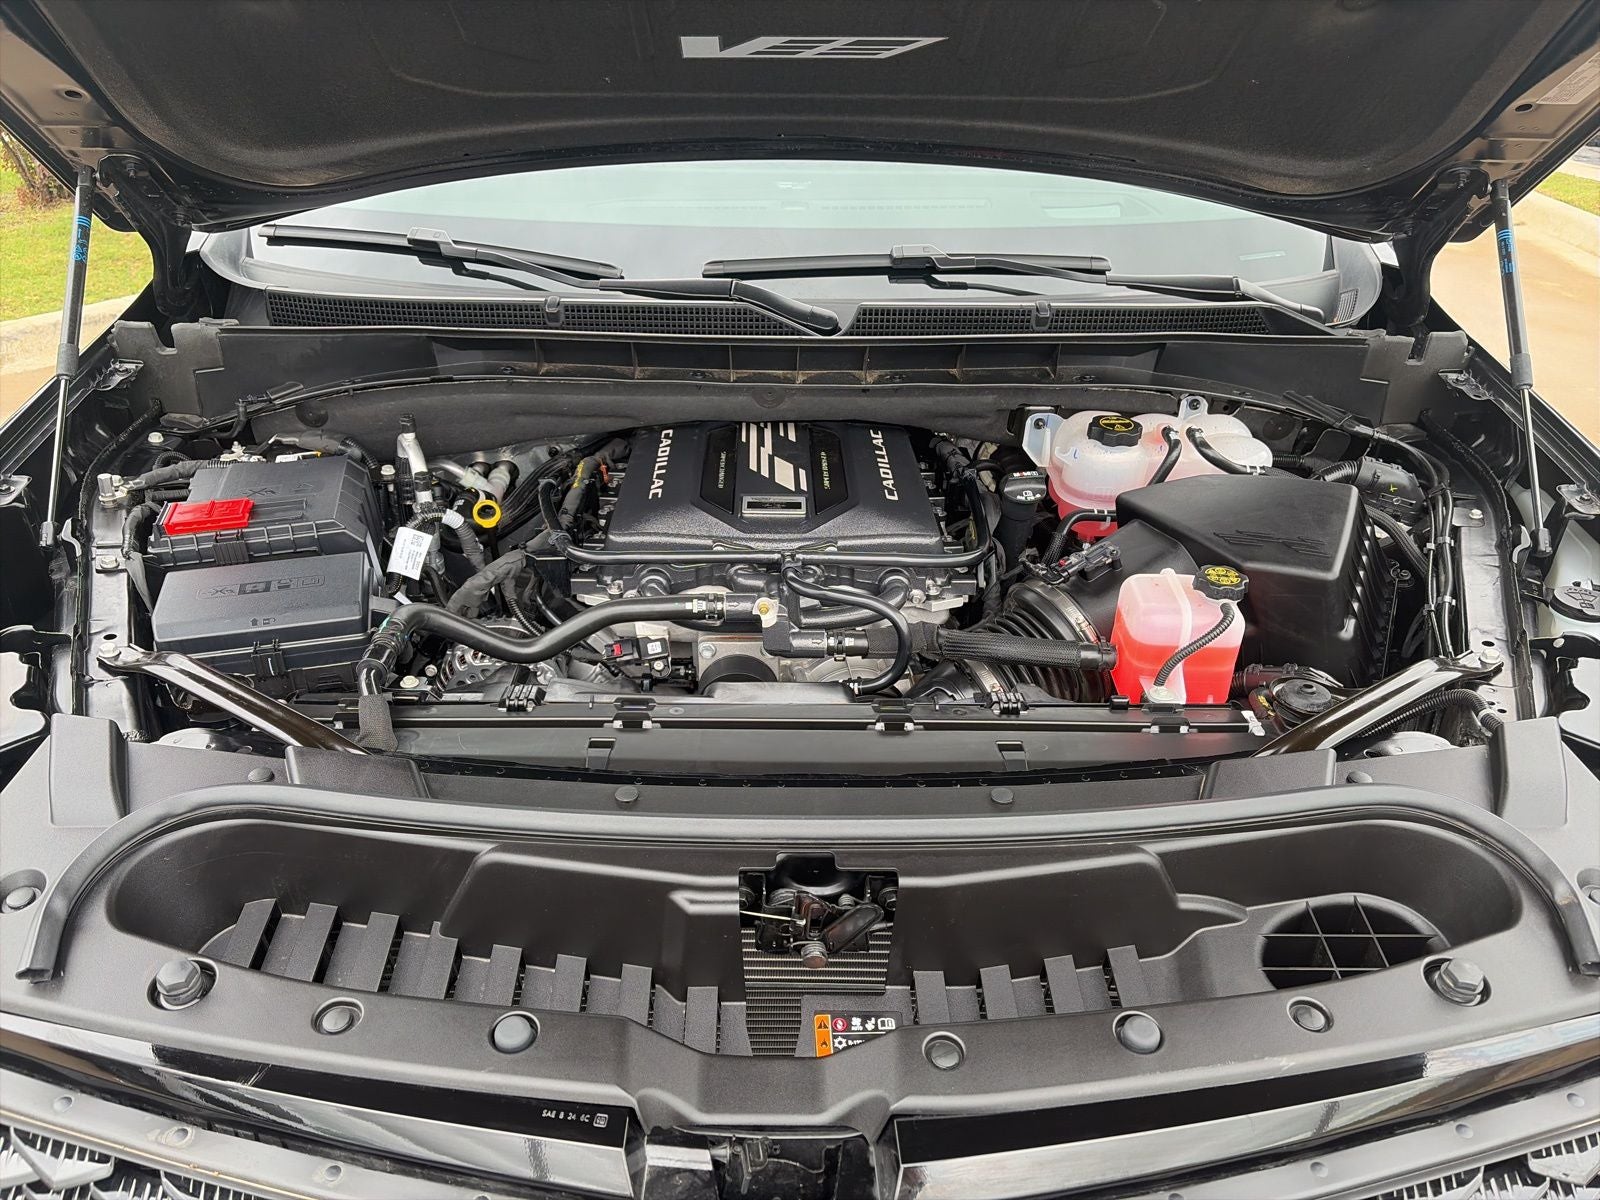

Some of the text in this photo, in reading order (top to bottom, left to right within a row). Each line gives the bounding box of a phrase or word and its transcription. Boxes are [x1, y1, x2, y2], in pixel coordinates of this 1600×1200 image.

[648, 429, 673, 499] CADILLAC
[869, 429, 898, 500] CADILLAC
[541, 1109, 556, 1119] SAE
